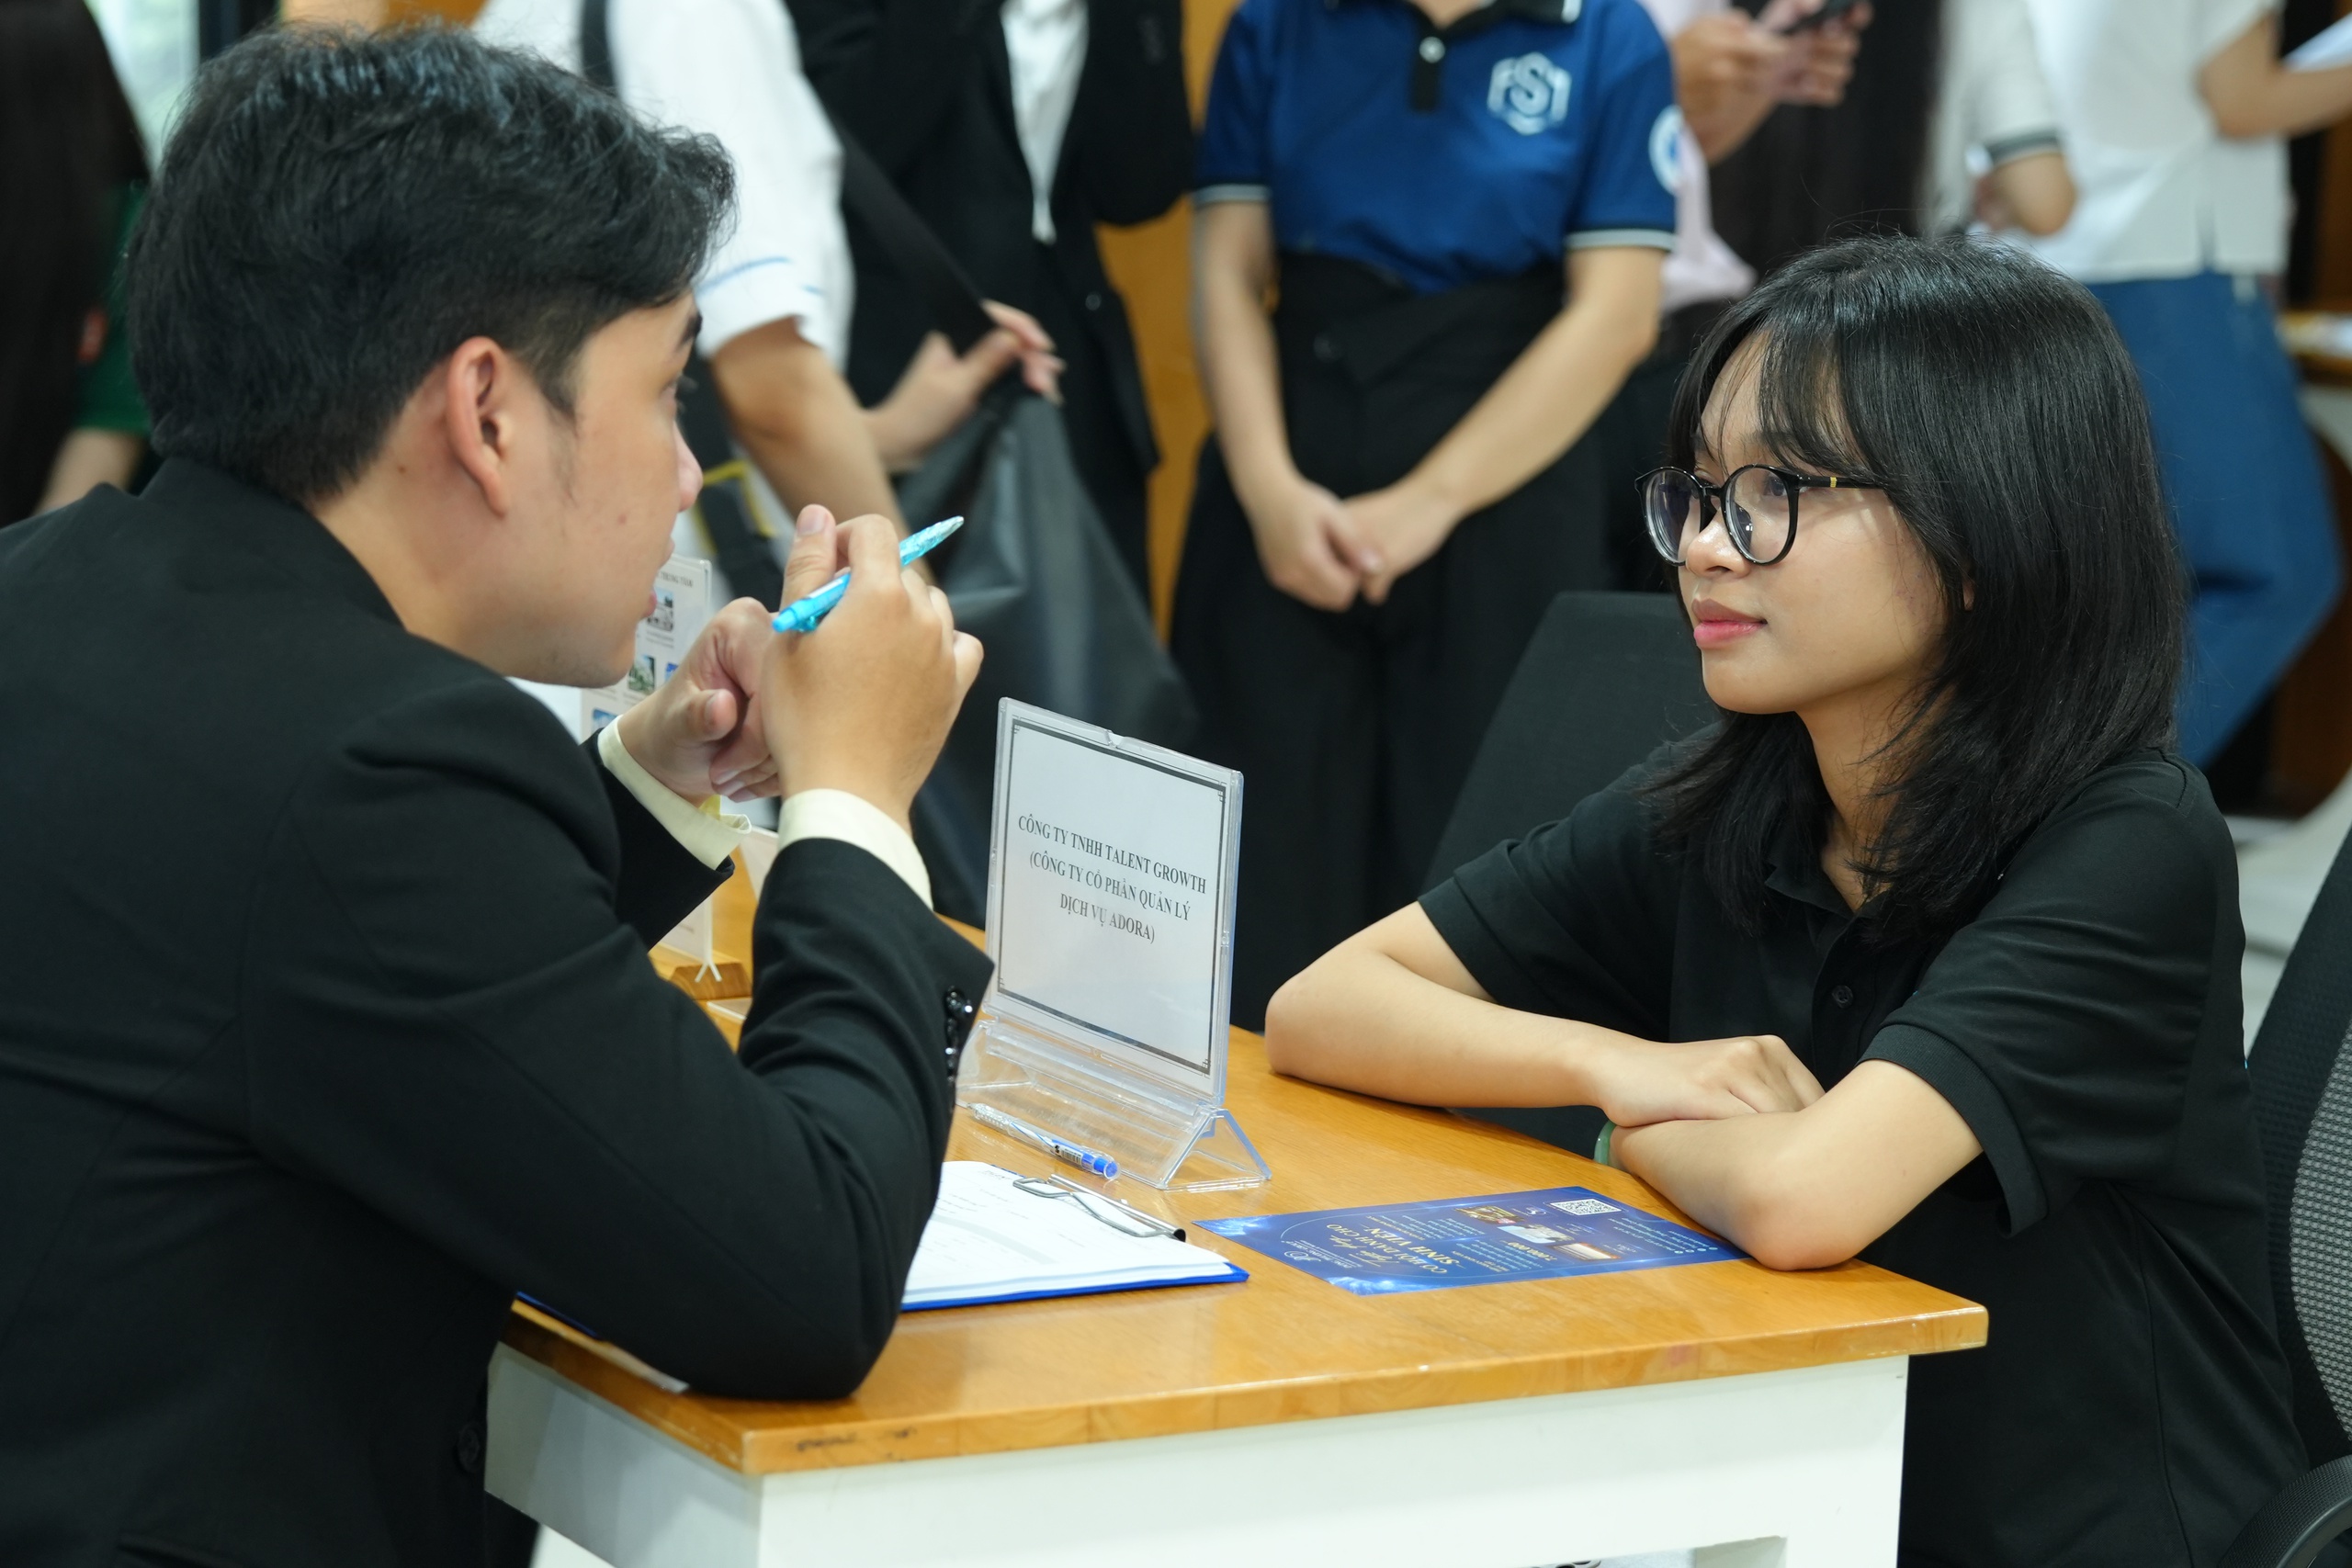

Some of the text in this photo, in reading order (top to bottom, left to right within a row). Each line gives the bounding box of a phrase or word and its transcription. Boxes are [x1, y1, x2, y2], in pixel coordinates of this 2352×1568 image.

[1019, 814, 1206, 894] CÔNG TY TNHH TALENT GROWTH
[1030, 851, 1191, 920] (CÔNG TY CỔ PHẦN QUẢN LÝ
[1060, 894, 1155, 943] DỊCH VỤ ADORA)
[1327, 1224, 1360, 1236] CHO
[1364, 1228, 1412, 1247] VIÊN
[1354, 1236, 1400, 1253] DÀNH
[1408, 1246, 1459, 1265] SINH
